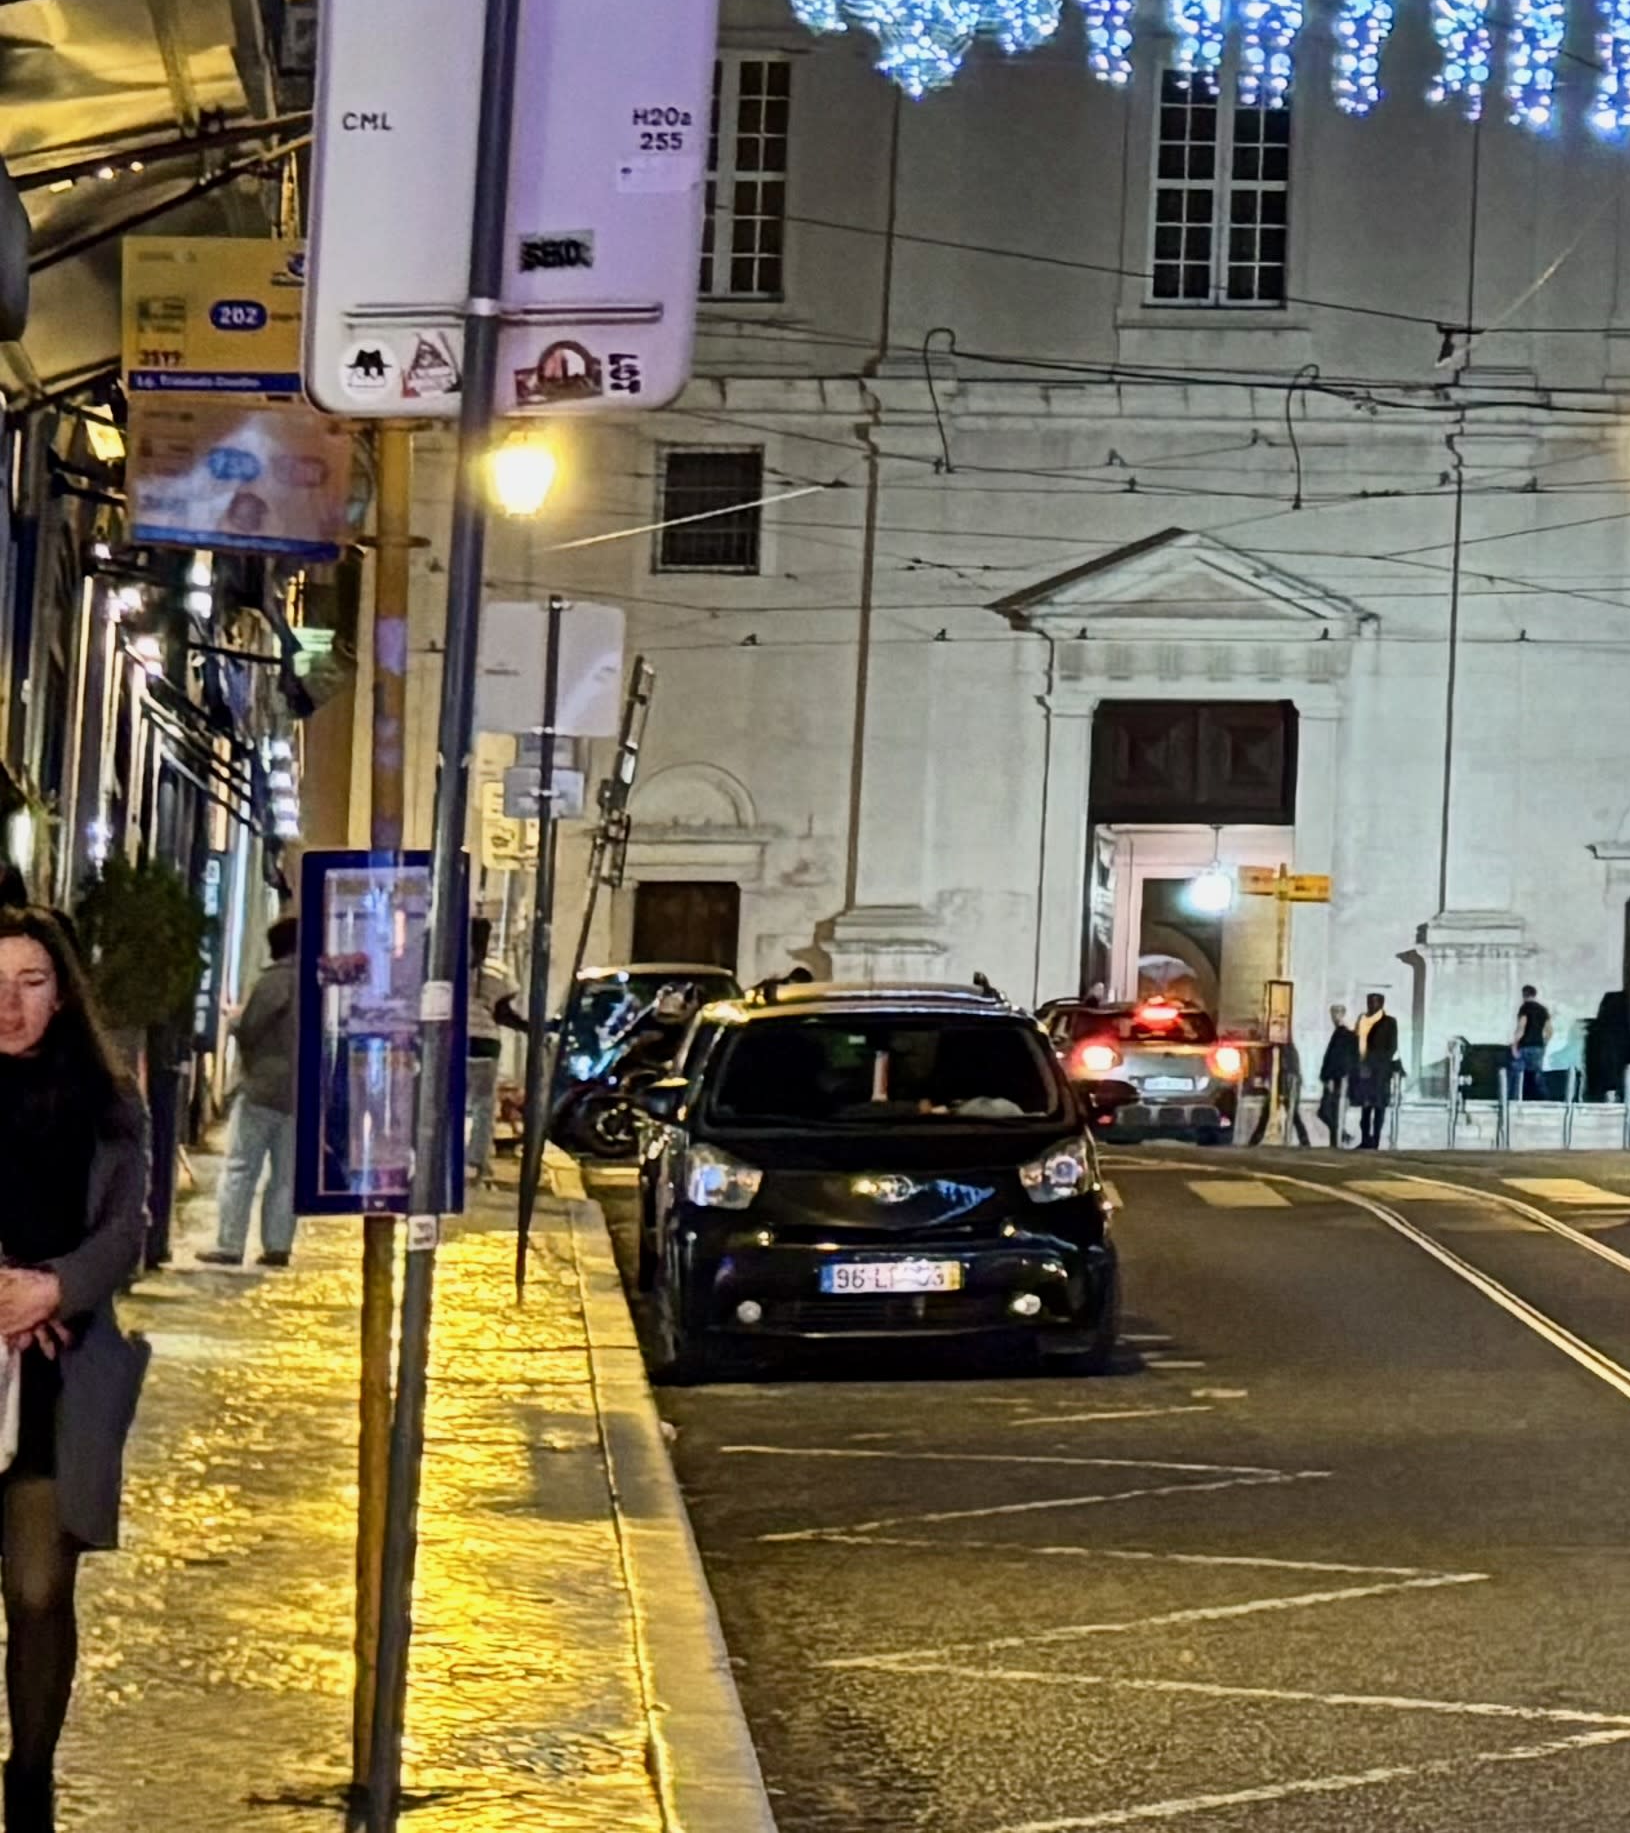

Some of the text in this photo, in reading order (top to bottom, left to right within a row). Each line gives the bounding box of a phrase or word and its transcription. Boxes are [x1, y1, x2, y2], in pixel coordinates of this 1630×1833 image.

[342, 111, 392, 131] CML
[639, 131, 683, 150] 255
[836, 1268, 866, 1289] 96
